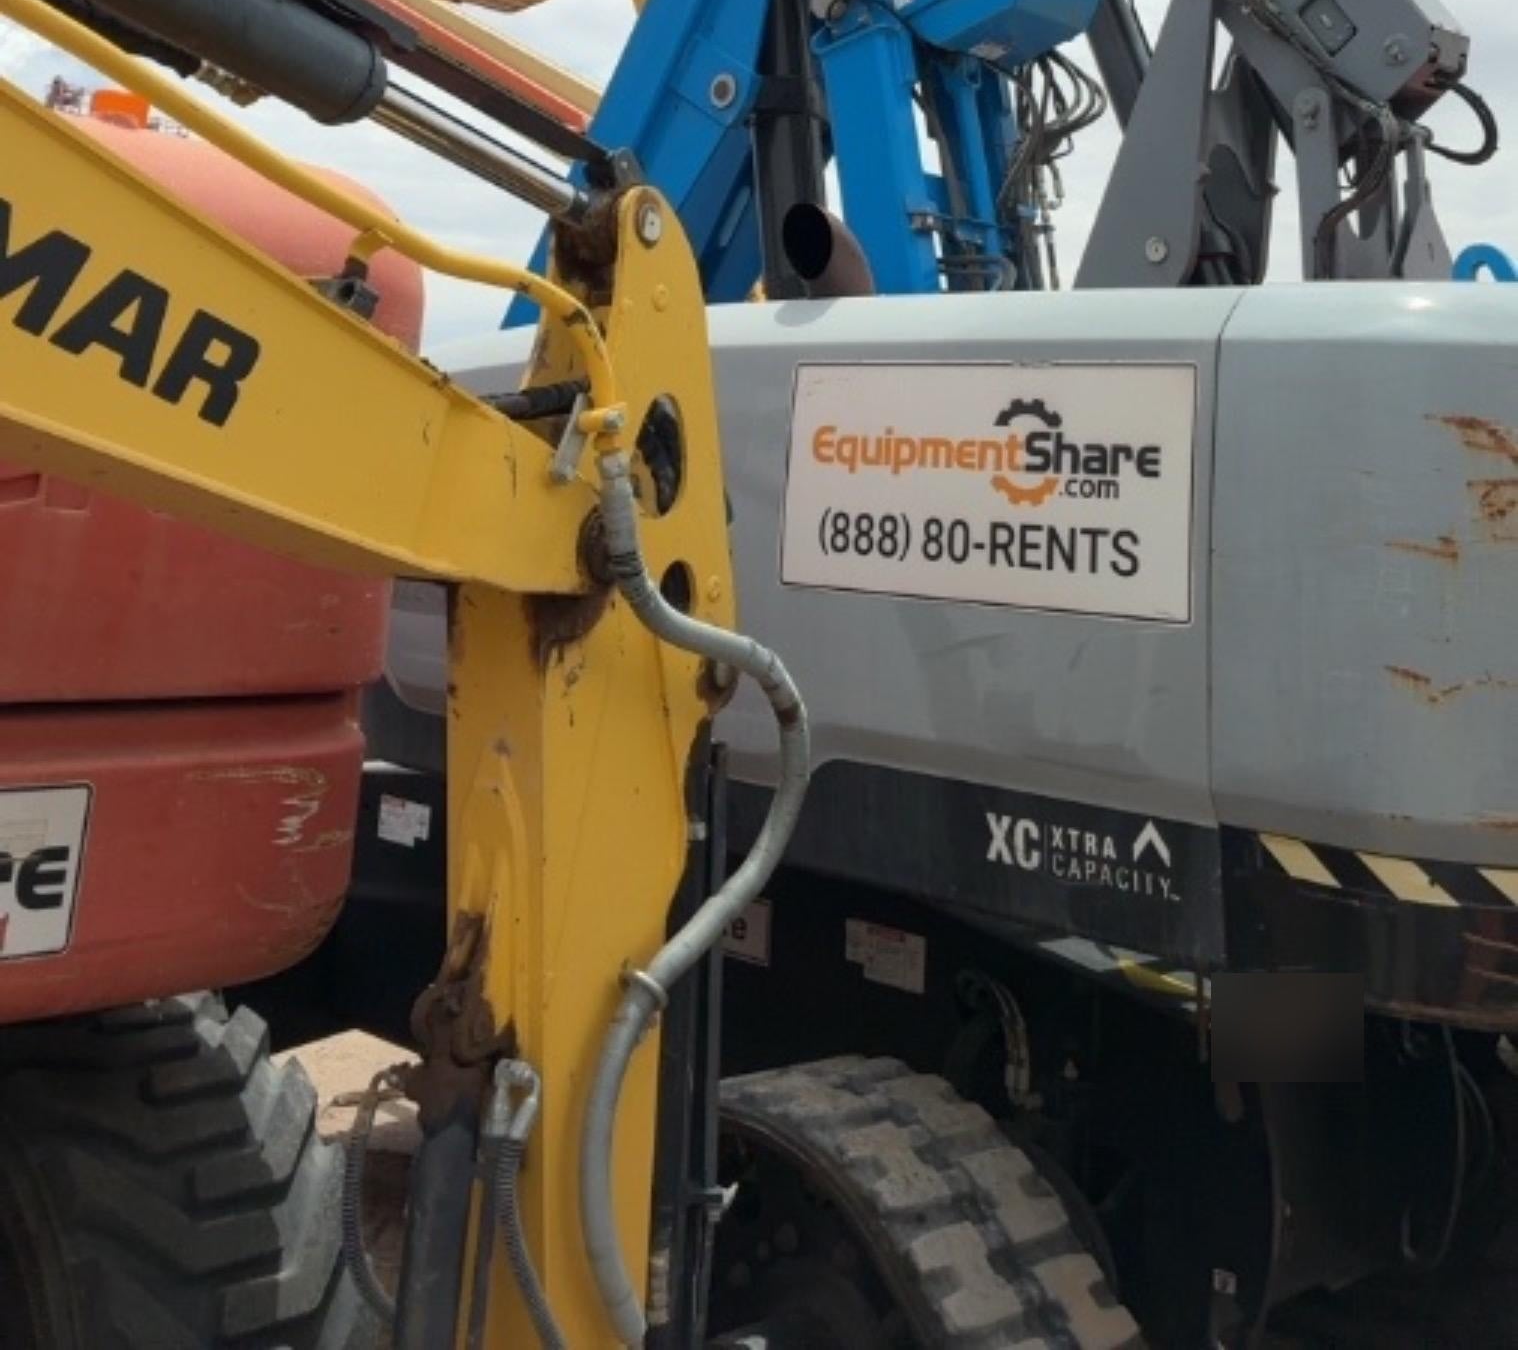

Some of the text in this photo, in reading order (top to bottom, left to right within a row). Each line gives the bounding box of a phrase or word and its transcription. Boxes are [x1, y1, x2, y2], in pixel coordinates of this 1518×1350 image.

[811, 424, 1162, 479] EquipmentShare
[818, 507, 1141, 578] (888) 80-RENTS
[985, 811, 1042, 871] XC
[1052, 824, 1118, 860] XTRA
